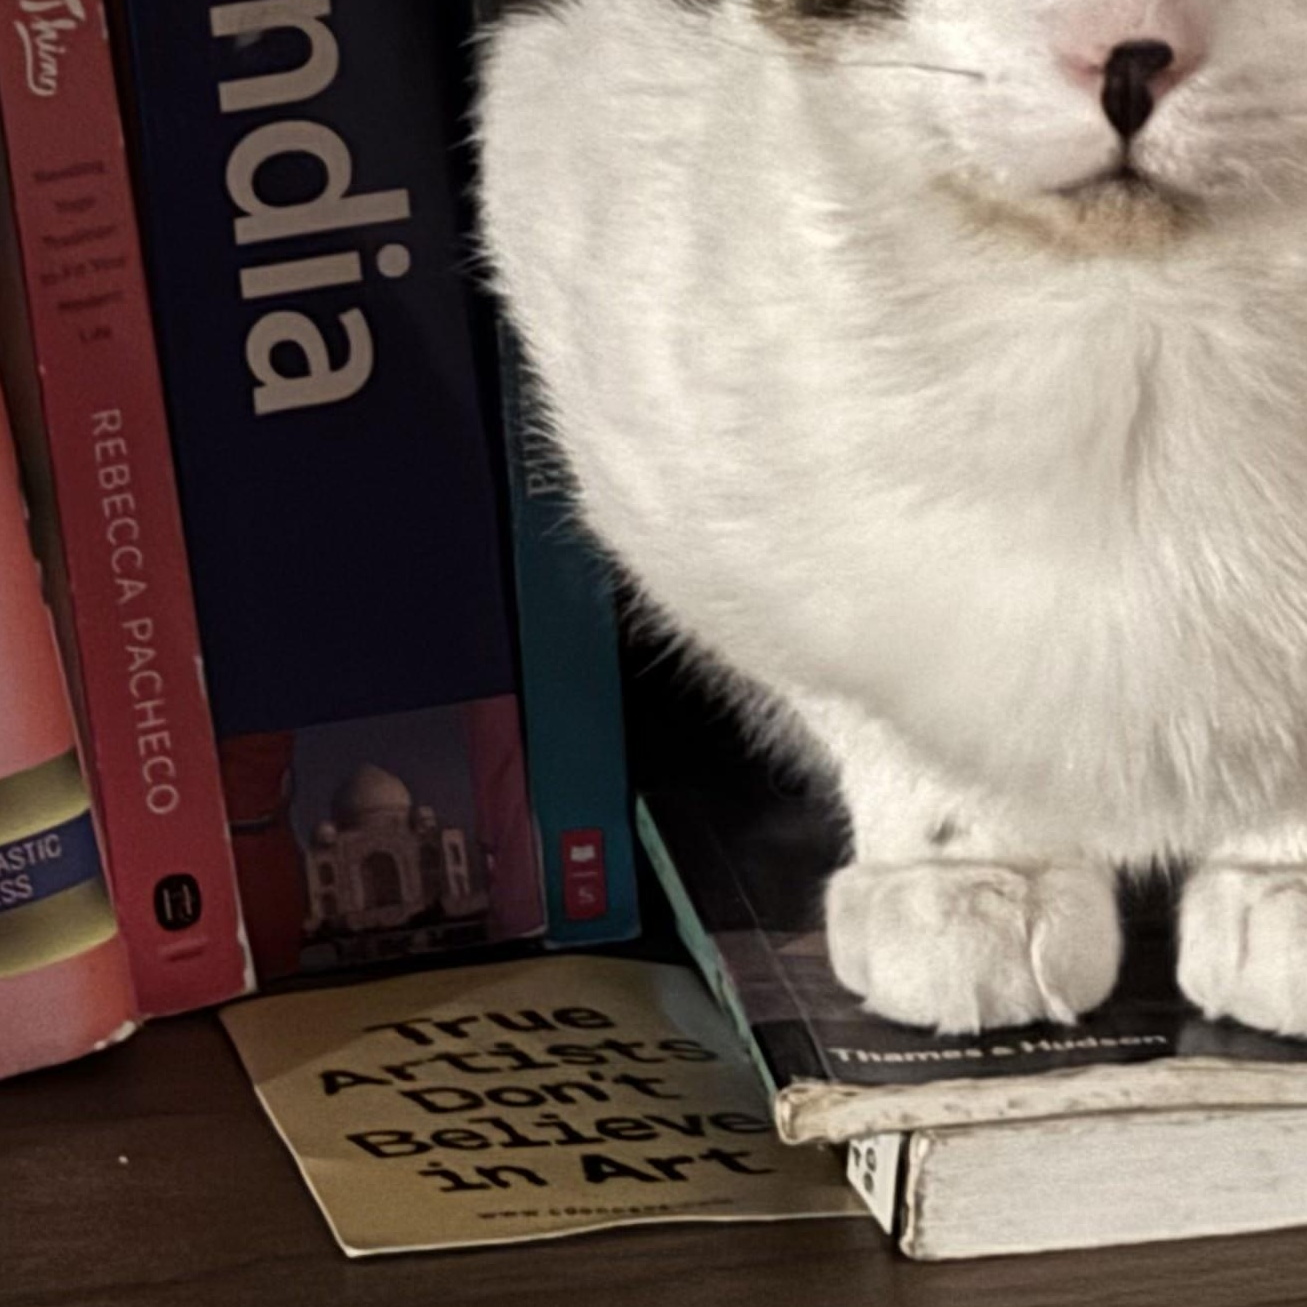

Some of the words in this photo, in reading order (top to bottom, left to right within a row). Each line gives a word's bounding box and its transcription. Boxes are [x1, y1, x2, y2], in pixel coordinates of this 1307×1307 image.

[91, 407, 148, 606] REBECCA
[121, 616, 180, 816] PACHECO
[362, 1005, 617, 1047] True
[825, 1046, 984, 1064] Thames
[1019, 1033, 1168, 1054] Hudson
[318, 1036, 719, 1097] Artists
[400, 1070, 684, 1115] Don't
[345, 1110, 774, 1160] Believe
[417, 1160, 549, 1194] in
[578, 1146, 780, 1185] Art
